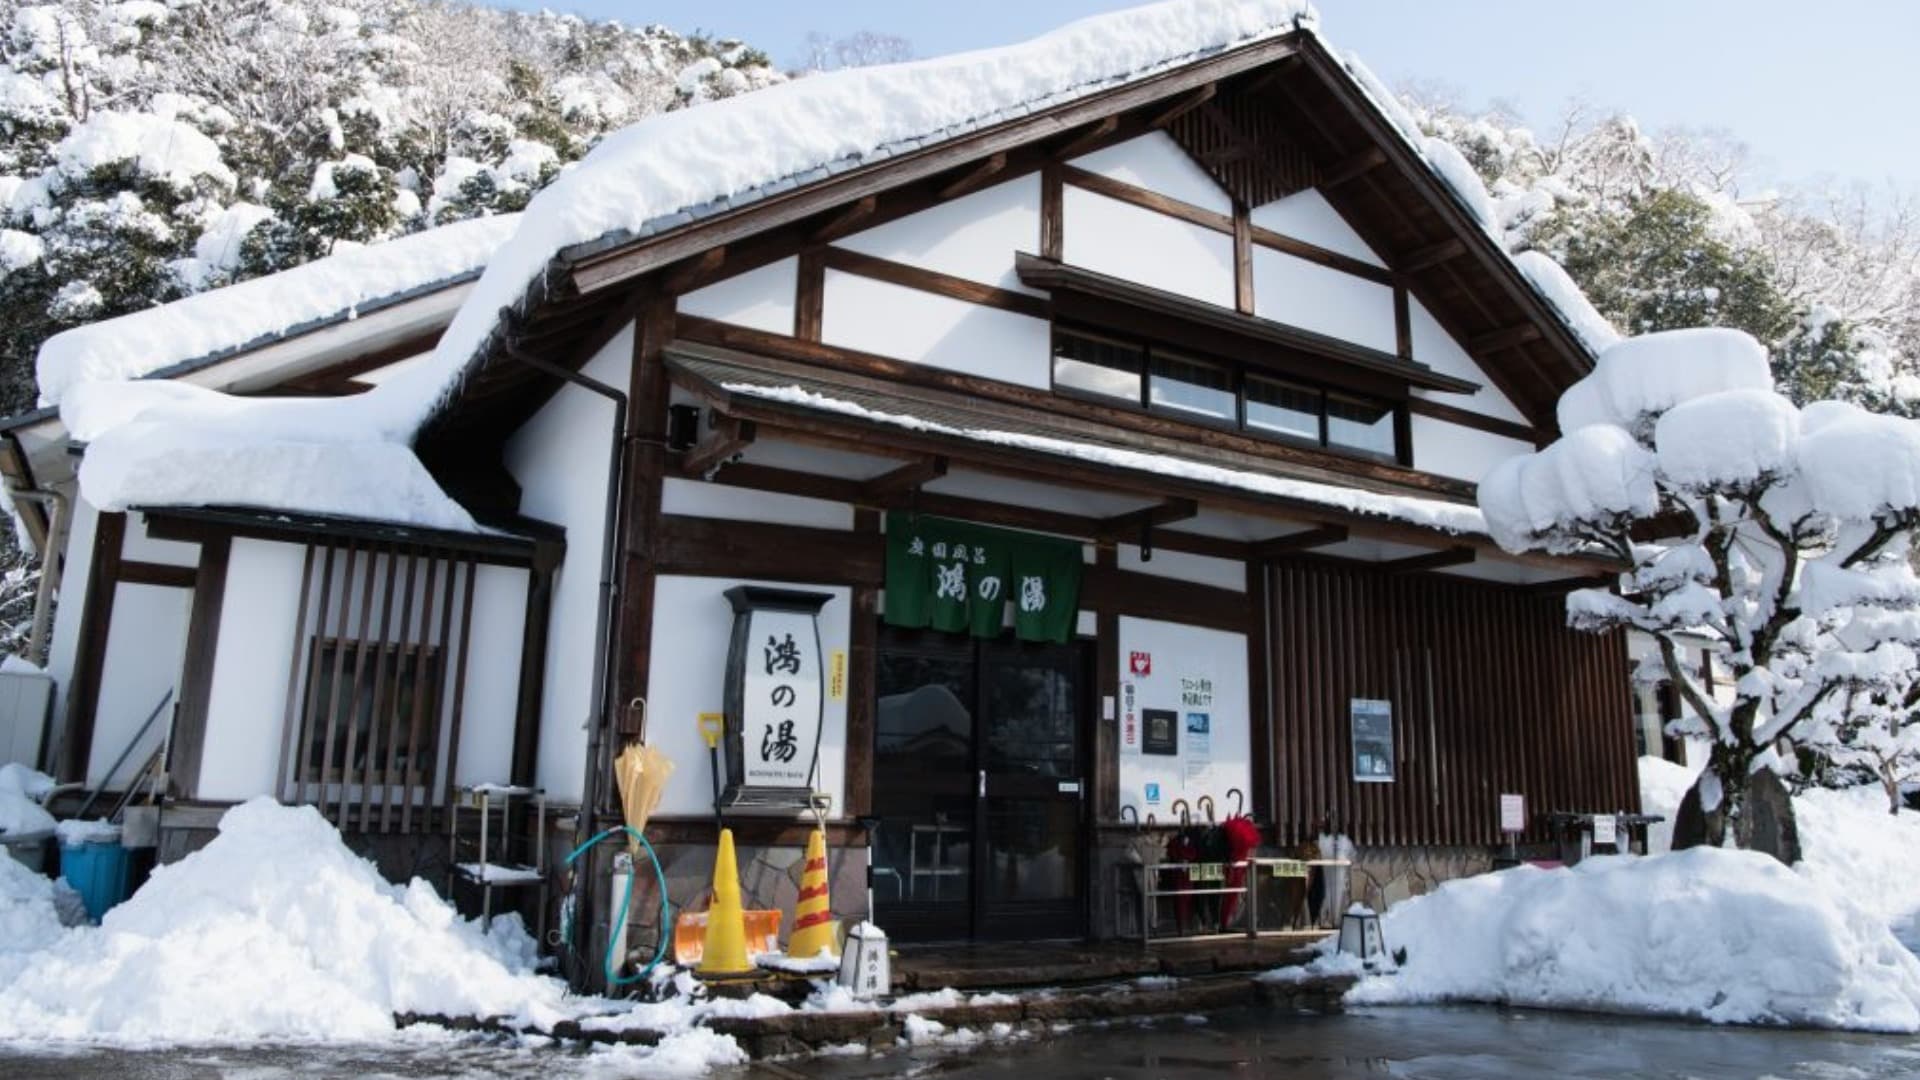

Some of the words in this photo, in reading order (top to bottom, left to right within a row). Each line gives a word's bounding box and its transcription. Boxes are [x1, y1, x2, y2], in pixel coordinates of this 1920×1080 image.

[937, 562, 1046, 612] 鴻の湯
[760, 633, 801, 763] 鴻の湯
